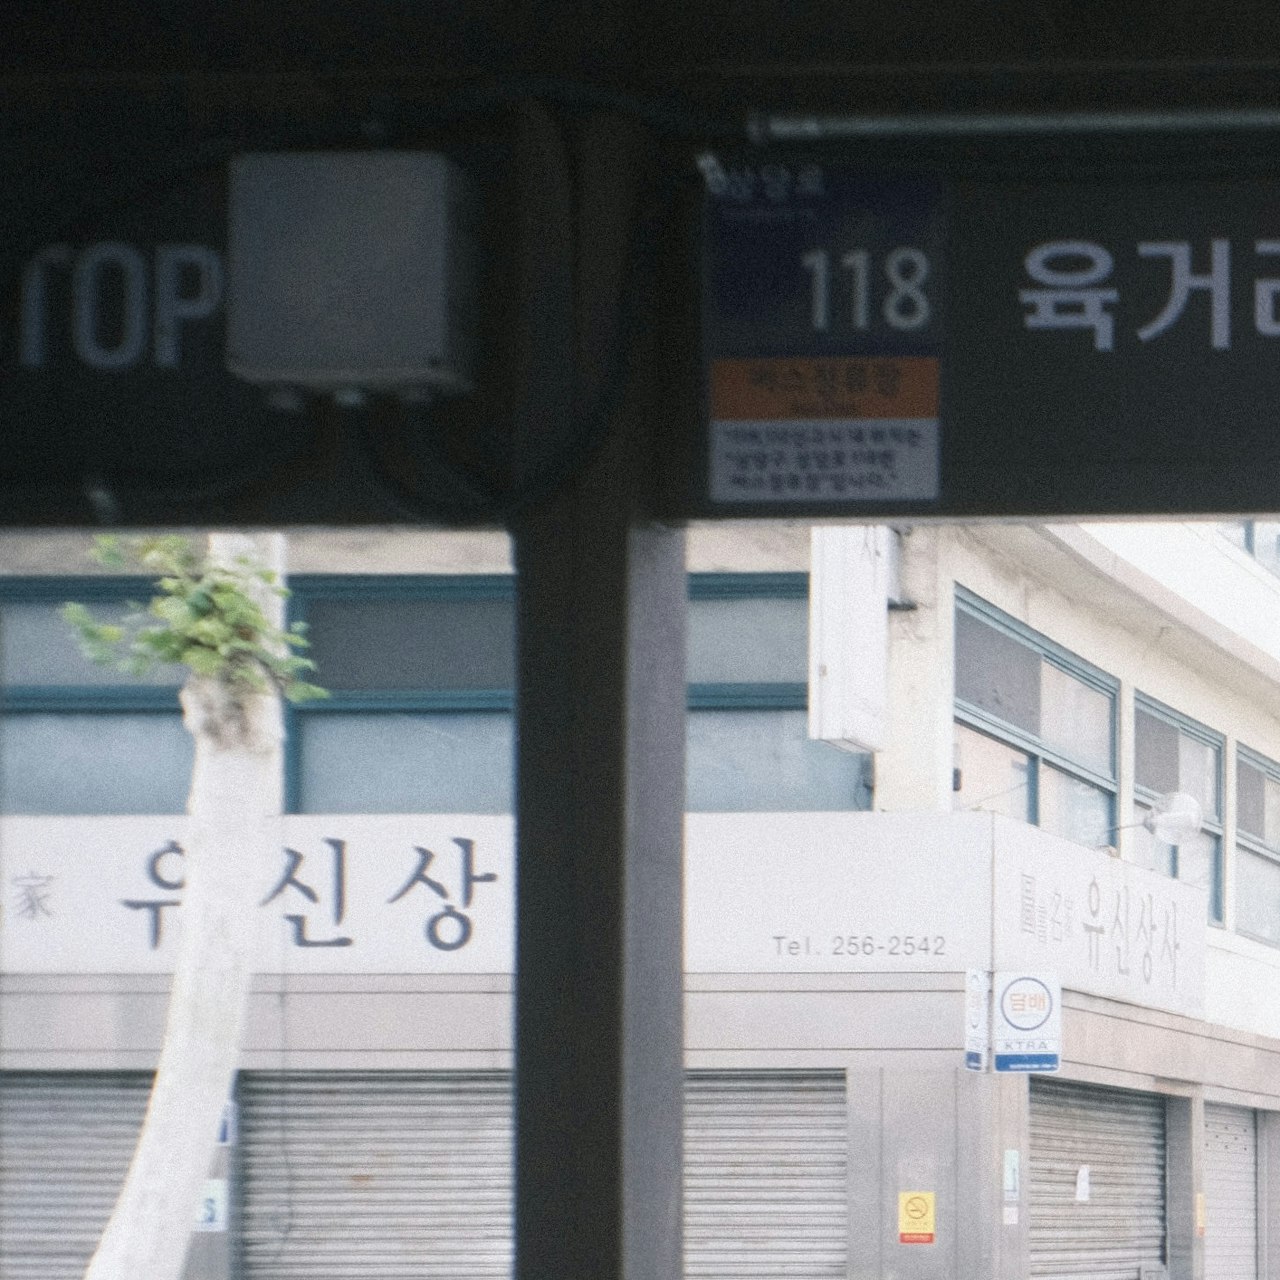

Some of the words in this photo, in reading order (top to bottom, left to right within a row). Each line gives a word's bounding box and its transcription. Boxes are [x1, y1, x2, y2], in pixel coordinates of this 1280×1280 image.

[801, 246, 931, 331] 118
[773, 935, 821, 956] Tel.
[832, 935, 946, 956] 256-2542
[1082, 874, 1181, 991] 유신상사
